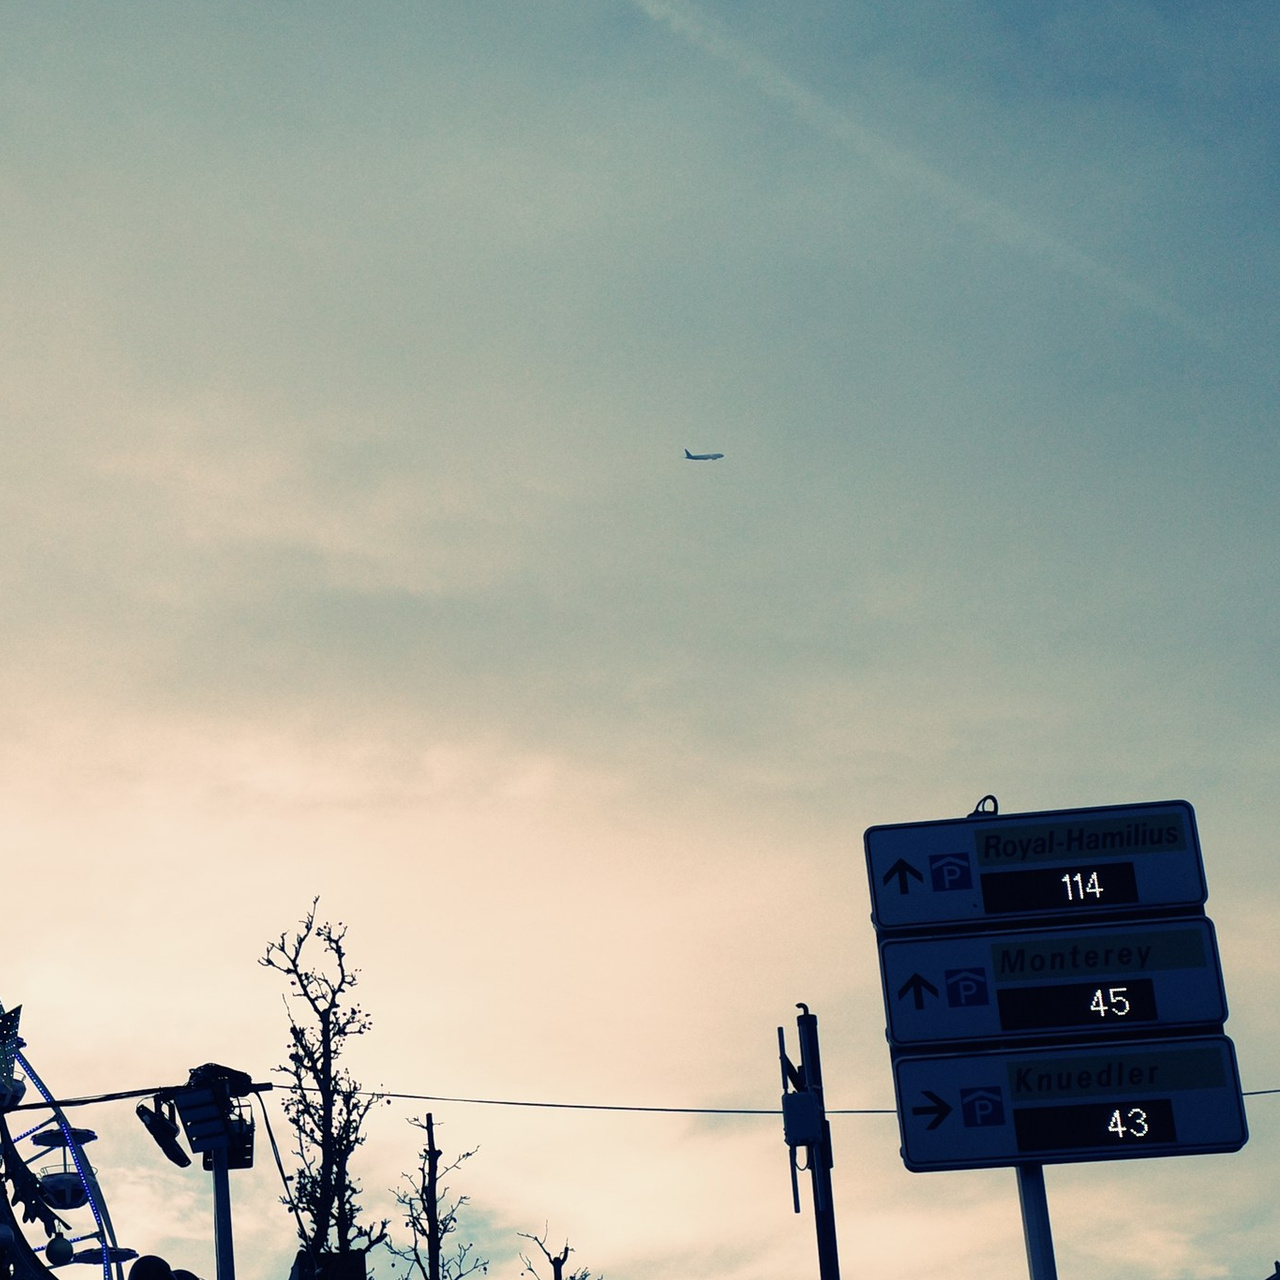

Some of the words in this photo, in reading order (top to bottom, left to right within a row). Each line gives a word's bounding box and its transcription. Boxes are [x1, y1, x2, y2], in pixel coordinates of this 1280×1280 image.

[984, 822, 1179, 860] Royal-Hamilius
[1061, 871, 1104, 901] 114
[1000, 942, 1152, 973] Monterey
[1089, 986, 1131, 1018] 45
[1016, 1062, 1160, 1093] Knuedler
[1107, 1108, 1150, 1139] 43
